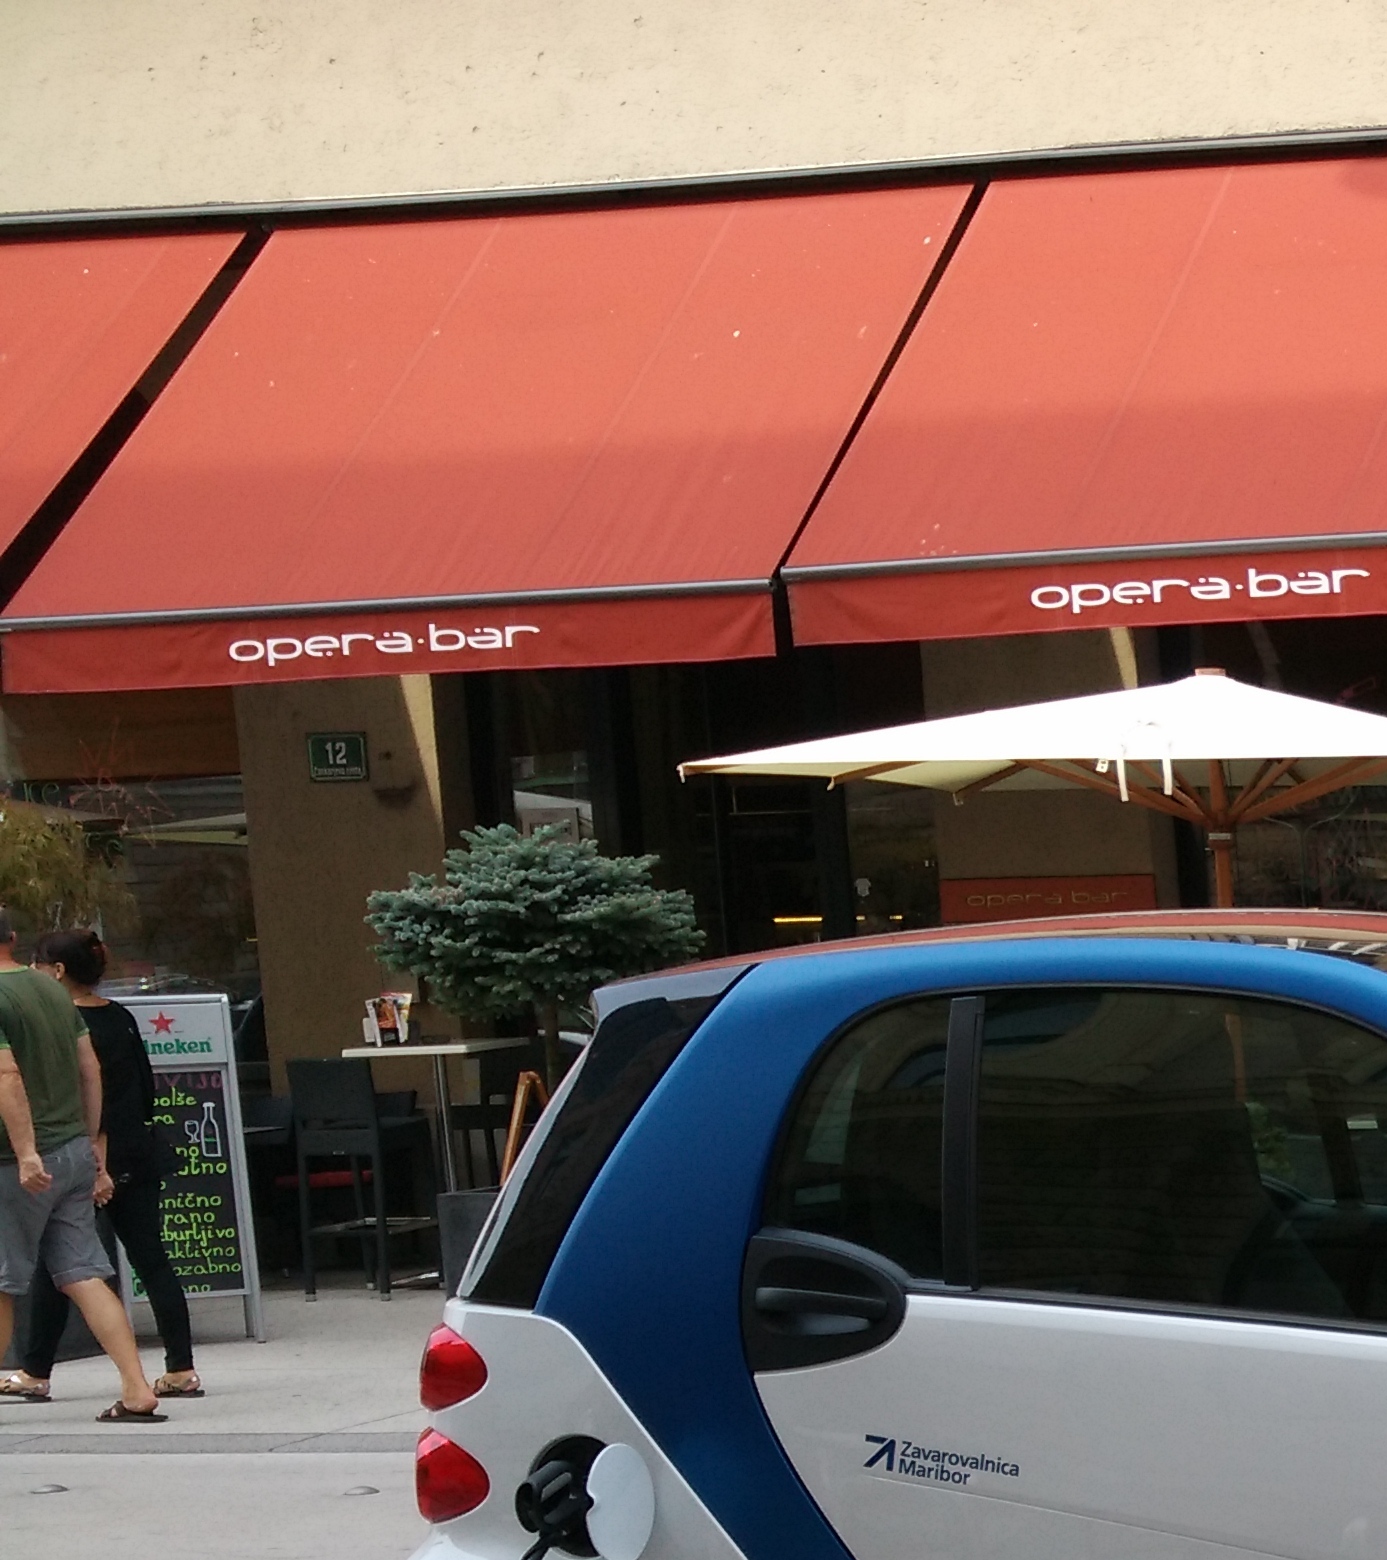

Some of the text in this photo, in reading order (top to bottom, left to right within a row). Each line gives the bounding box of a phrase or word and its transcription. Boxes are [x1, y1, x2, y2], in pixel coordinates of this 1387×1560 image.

[325, 742, 347, 764] 12
[1071, 890, 1128, 904] bar
[143, 1038, 213, 1055] ineken
[900, 1440, 1020, 1477] Zavarovalnica
[898, 1459, 971, 1485] Maribor
